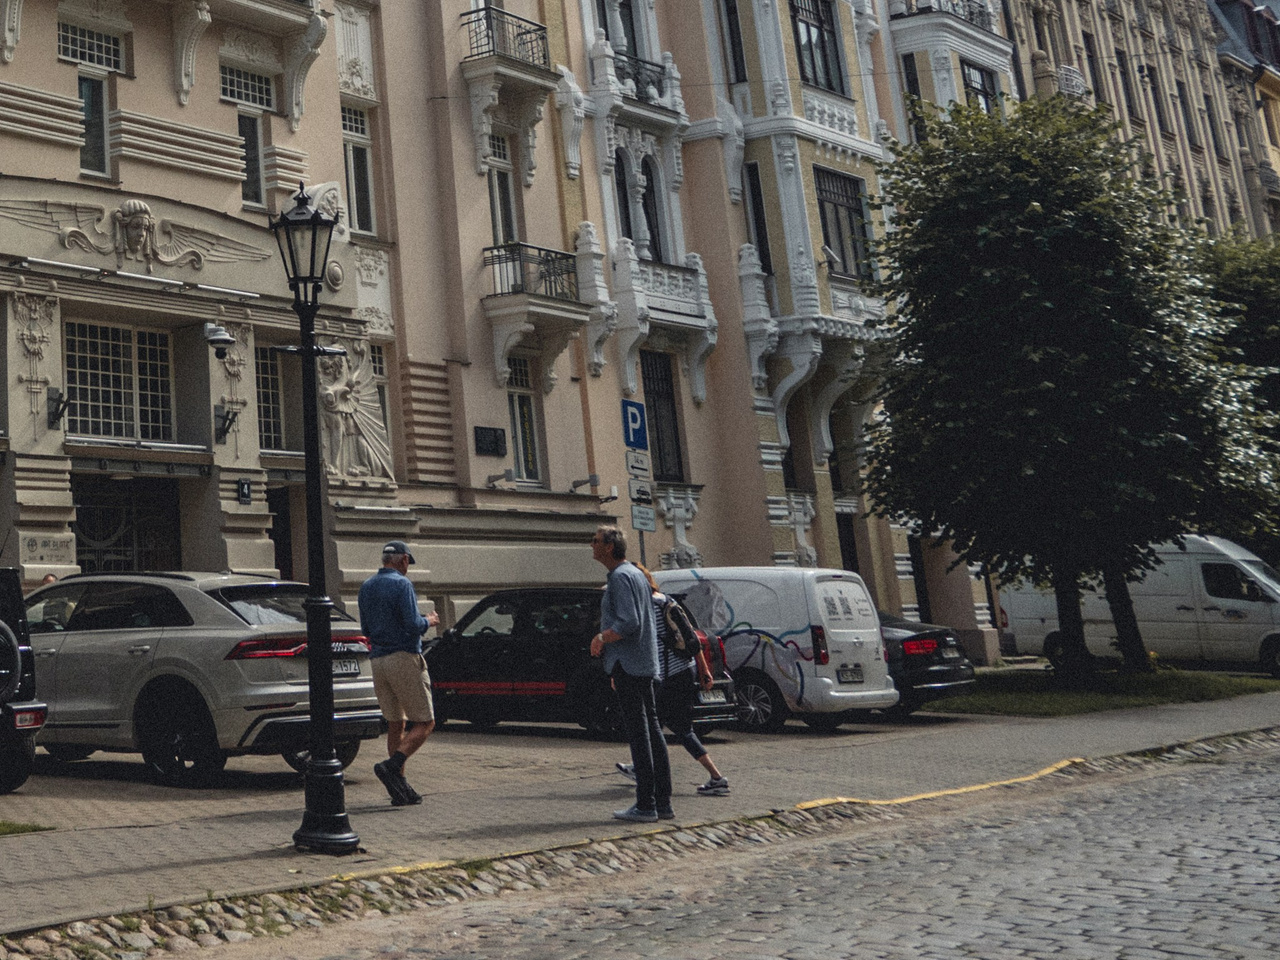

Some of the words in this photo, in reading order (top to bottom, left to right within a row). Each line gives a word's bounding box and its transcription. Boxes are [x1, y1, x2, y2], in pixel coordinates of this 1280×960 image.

[627, 406, 641, 442] P
[243, 484, 249, 495] 4
[332, 660, 358, 672] -1572
